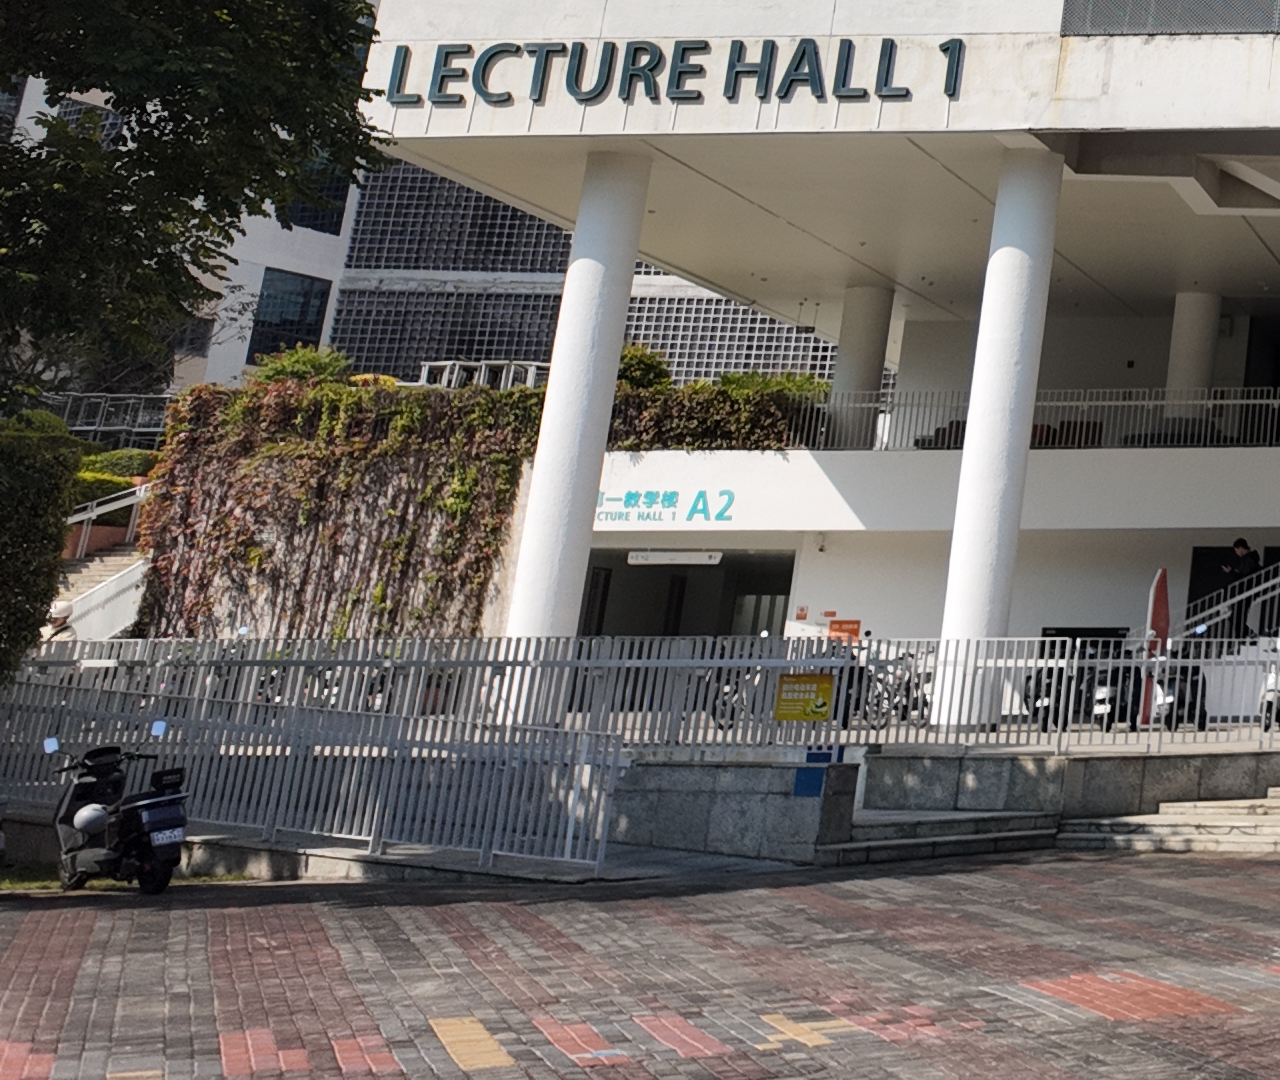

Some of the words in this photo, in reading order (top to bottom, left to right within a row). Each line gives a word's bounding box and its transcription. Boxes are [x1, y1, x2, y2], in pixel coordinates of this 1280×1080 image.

[386, 40, 709, 103] LECTURE
[723, 38, 910, 100] HALL
[938, 38, 964, 98] 1
[594, 512, 631, 522] CTURE
[637, 511, 664, 522] HALL
[671, 511, 676, 521] 1
[686, 489, 735, 522] A2
